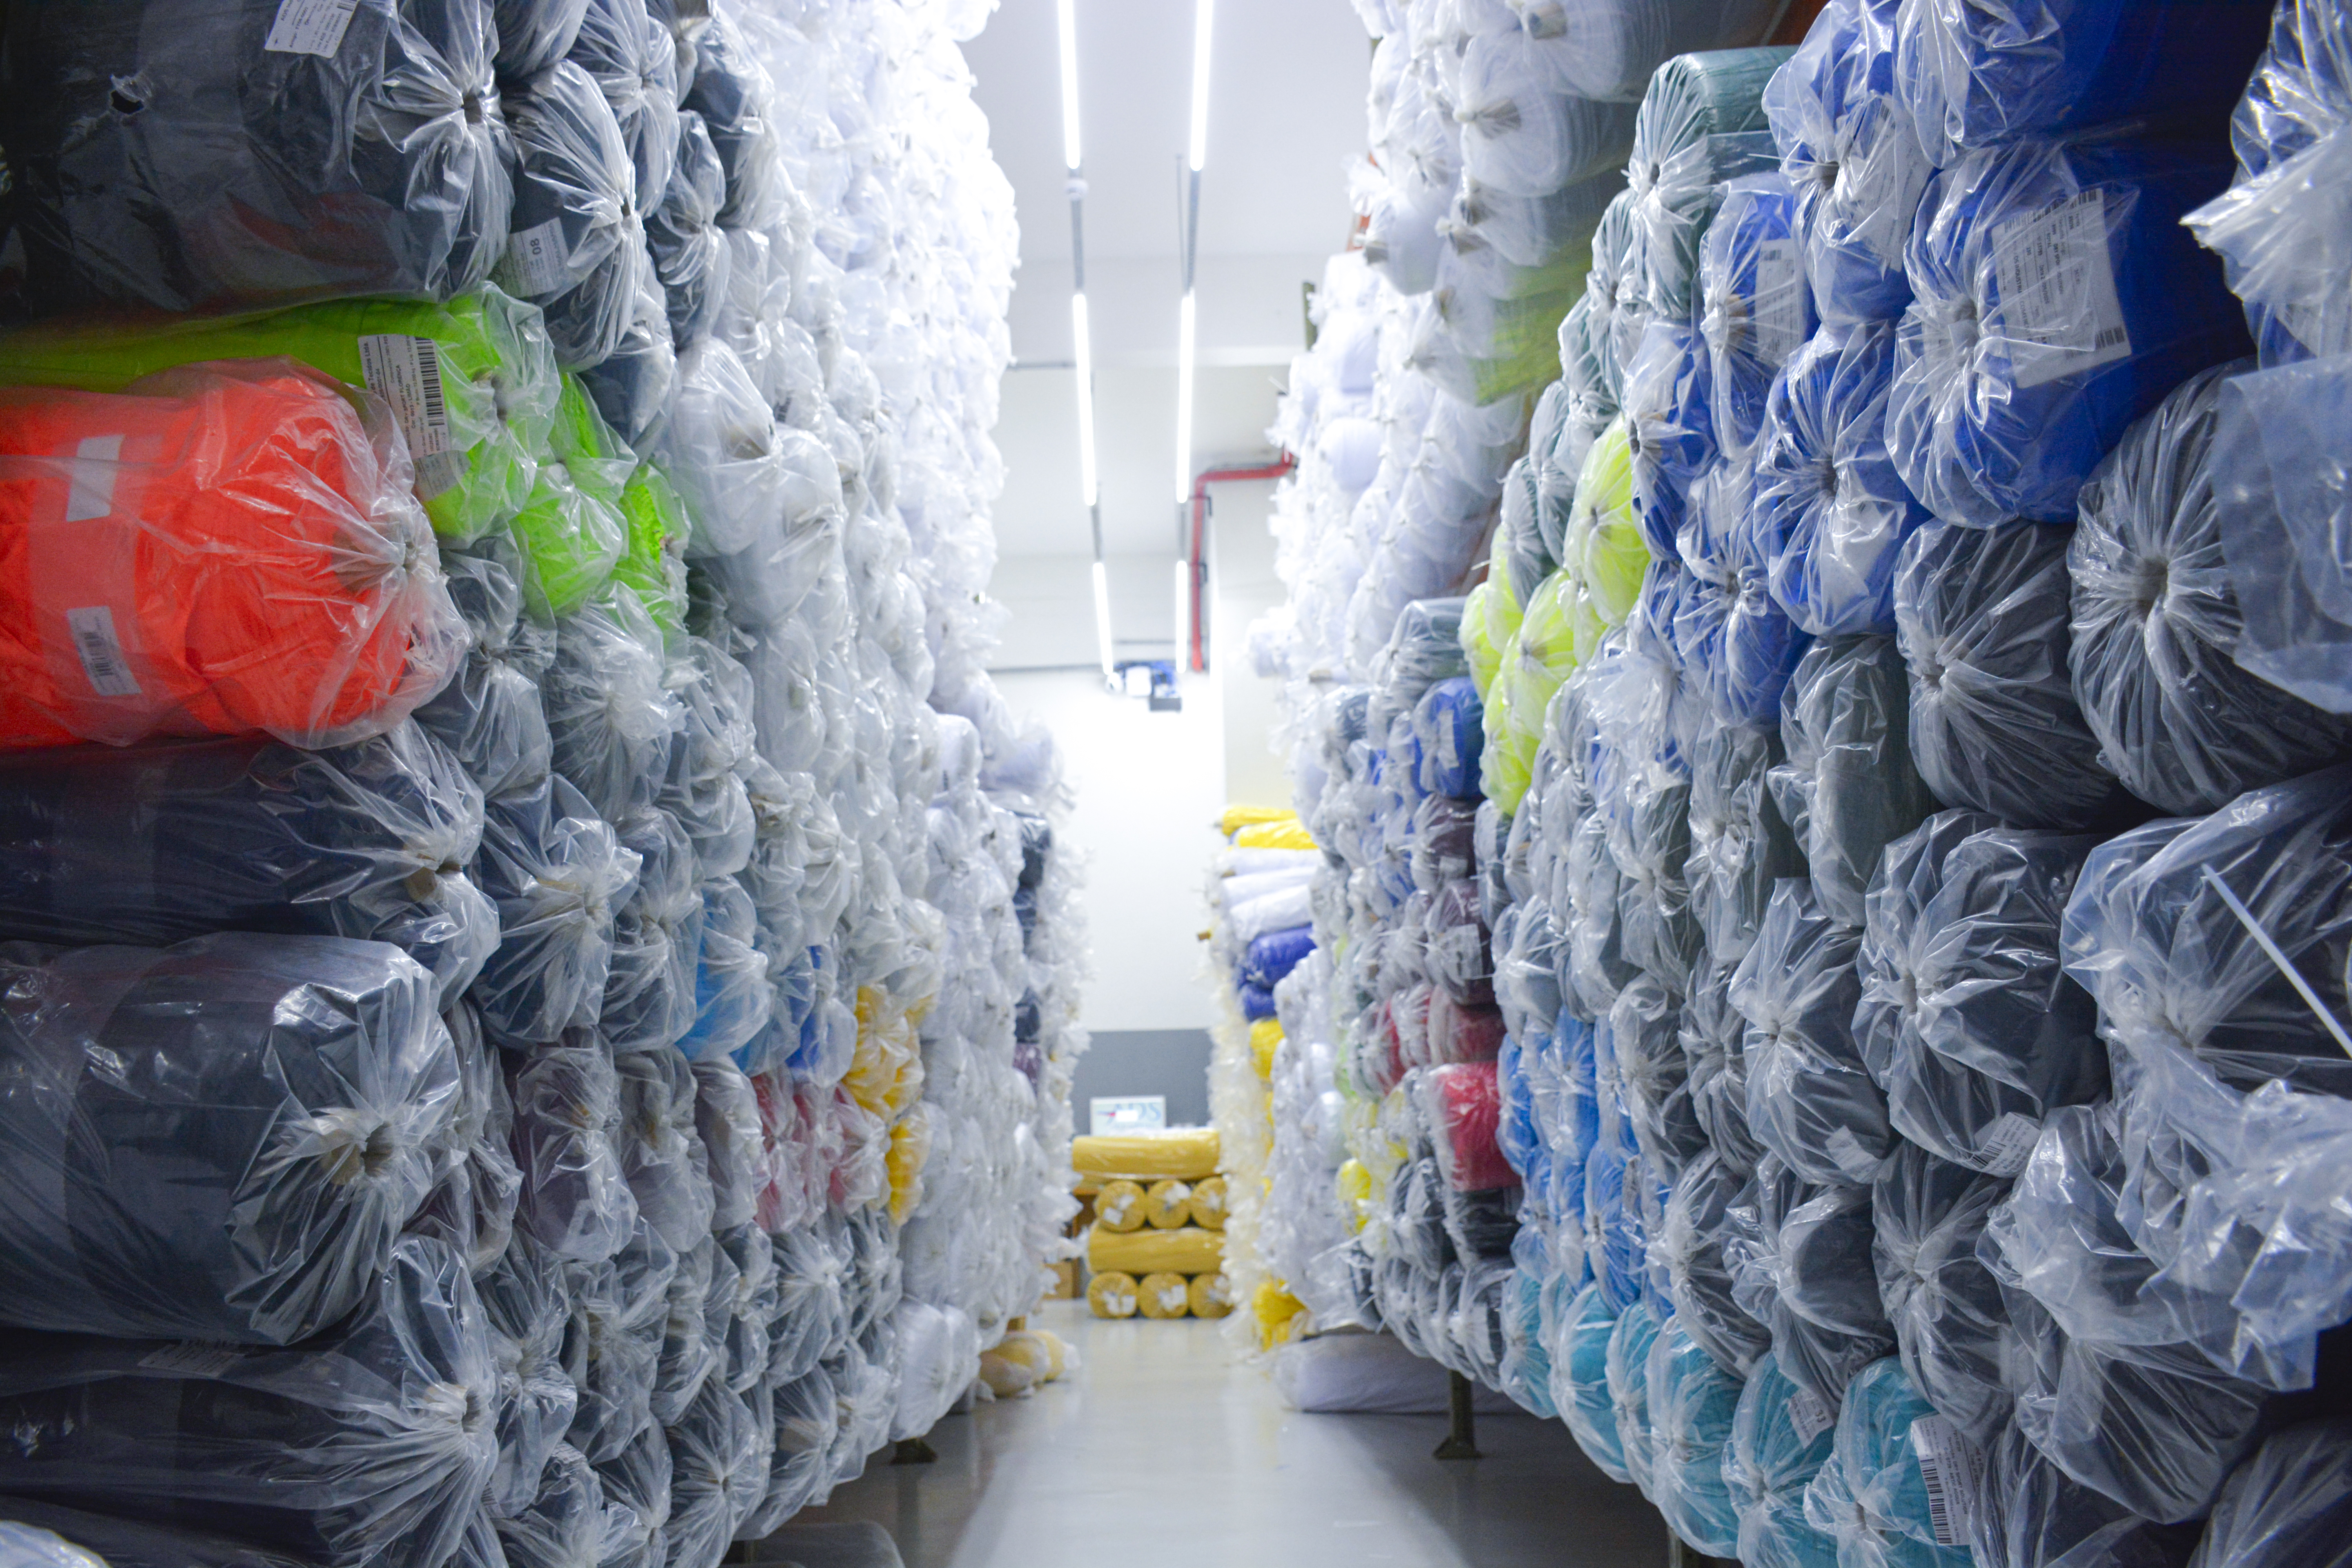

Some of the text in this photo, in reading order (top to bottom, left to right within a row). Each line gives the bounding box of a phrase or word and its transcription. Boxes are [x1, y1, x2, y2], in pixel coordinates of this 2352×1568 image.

[530, 238, 542, 255] 80
[366, 358, 374, 381] Tecidos
[396, 365, 405, 393] FLORENÇA
[1815, 1409, 1826, 1423] 33
[1959, 1489, 1968, 1514] SOLUTION
